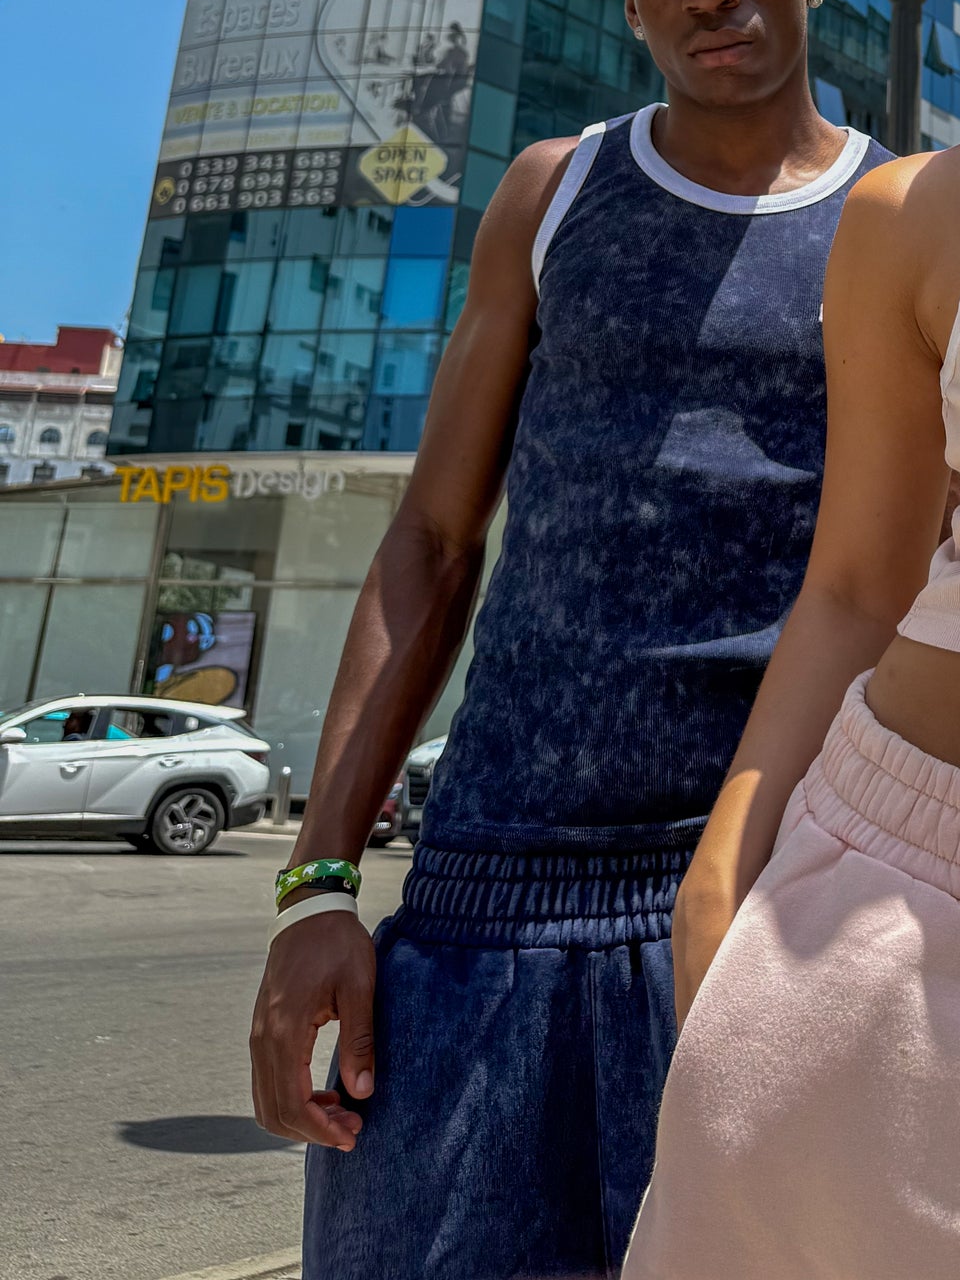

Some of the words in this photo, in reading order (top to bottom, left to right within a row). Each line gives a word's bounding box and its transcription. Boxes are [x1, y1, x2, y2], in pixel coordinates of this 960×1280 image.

[194, 0, 301, 40] Espaces
[178, 48, 300, 88] Bureaux
[373, 166, 429, 183] SPACE
[377, 147, 428, 163] OPEN
[114, 464, 230, 503] TAPIS
